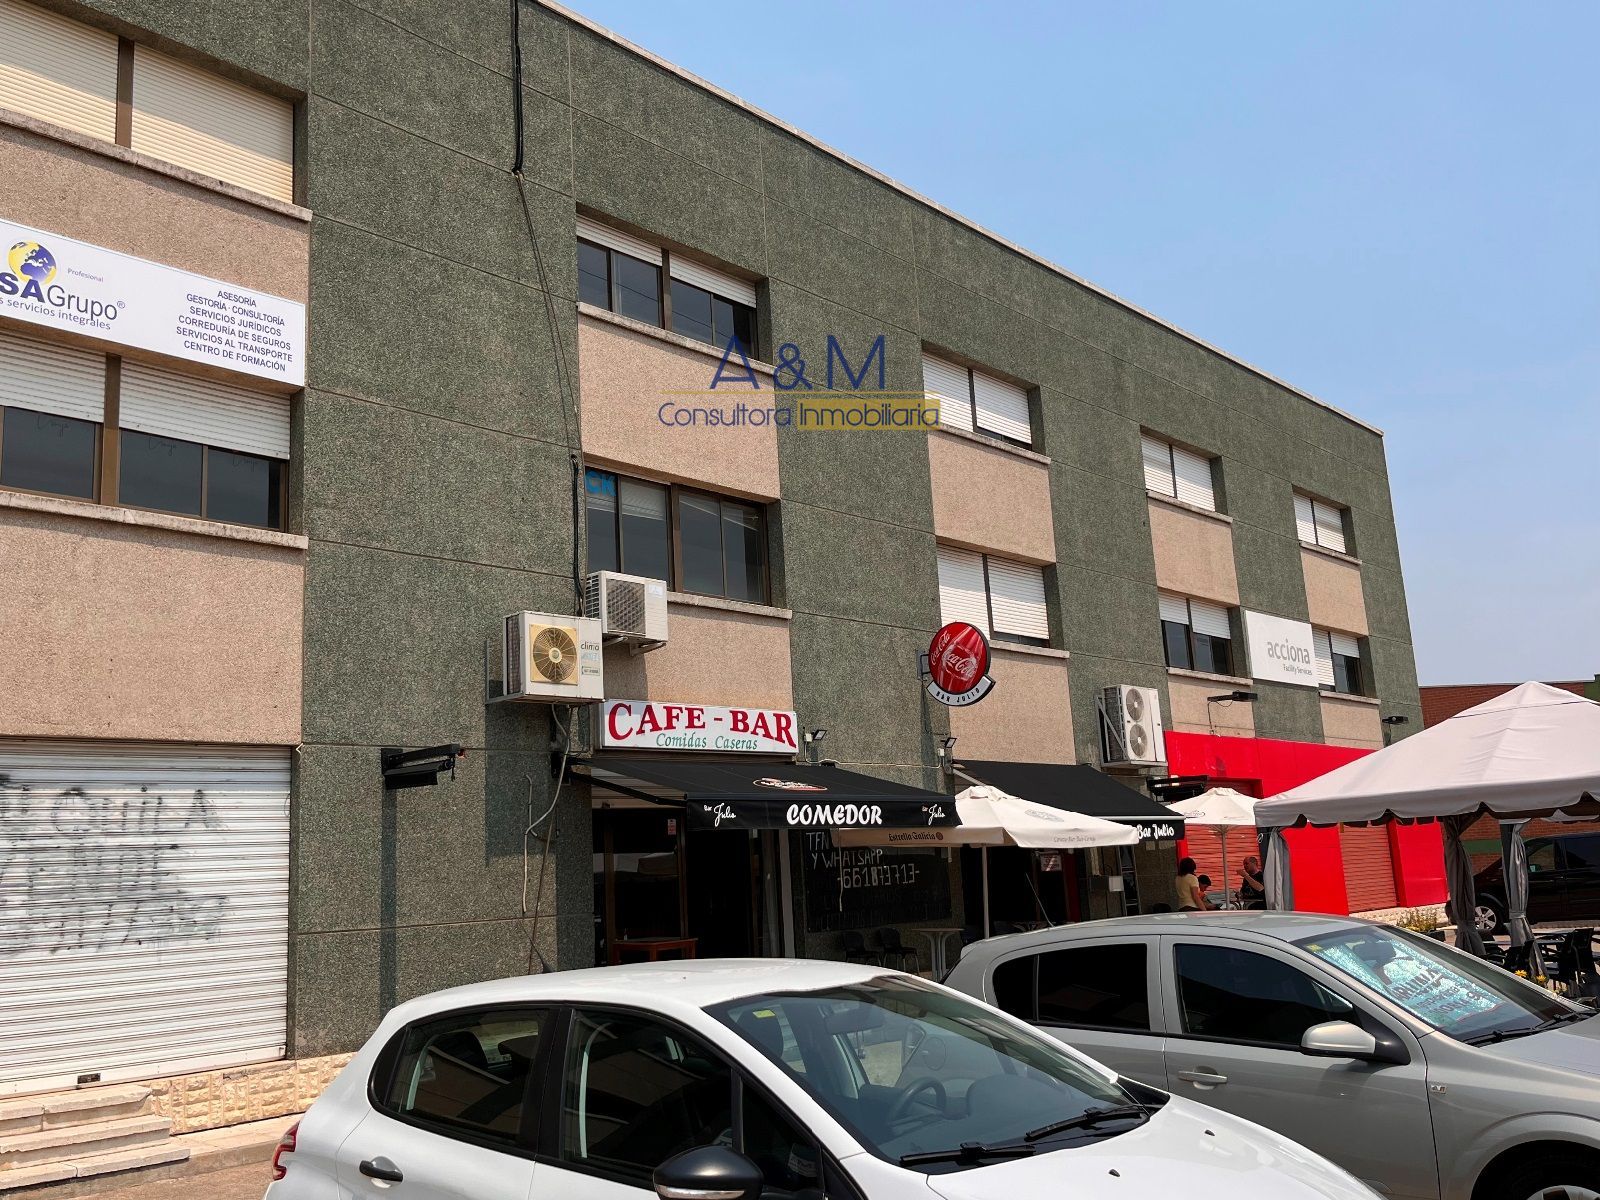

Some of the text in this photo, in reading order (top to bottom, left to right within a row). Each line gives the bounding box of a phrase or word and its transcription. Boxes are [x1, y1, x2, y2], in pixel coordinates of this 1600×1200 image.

[67, 267, 104, 283] Profesional
[186, 293, 228, 311] GESTORÍA
[232, 305, 285, 326] CONSULTORÍA
[217, 290, 257, 307] ASESORÍA
[7, 298, 56, 317] servicios
[58, 309, 111, 330] integrales
[190, 305, 282, 337] SERVICIOS JURÍDICOS
[176, 326, 293, 362] SERVICIOS AL TRANSPORTE
[178, 315, 291, 351] CORREDURÍA DE SEGUROS
[184, 340, 286, 372] CENTRO DE FORMACIÓN
[1267, 638, 1310, 665] acciona
[1283, 664, 1312, 676] Facility Services
[935, 687, 980, 703] BAR JULIO
[608, 703, 706, 741] CAFE
[729, 710, 797, 749] BAR
[656, 731, 758, 750] Comidas Caseras
[713, 803, 737, 828] Julio
[786, 804, 882, 826] COMEDOR
[928, 804, 946, 826] Julio
[888, 832, 936, 842] Estrella Galicia
[1136, 823, 1175, 840] Bar Julio
[821, 849, 883, 868] WHATSAPP
